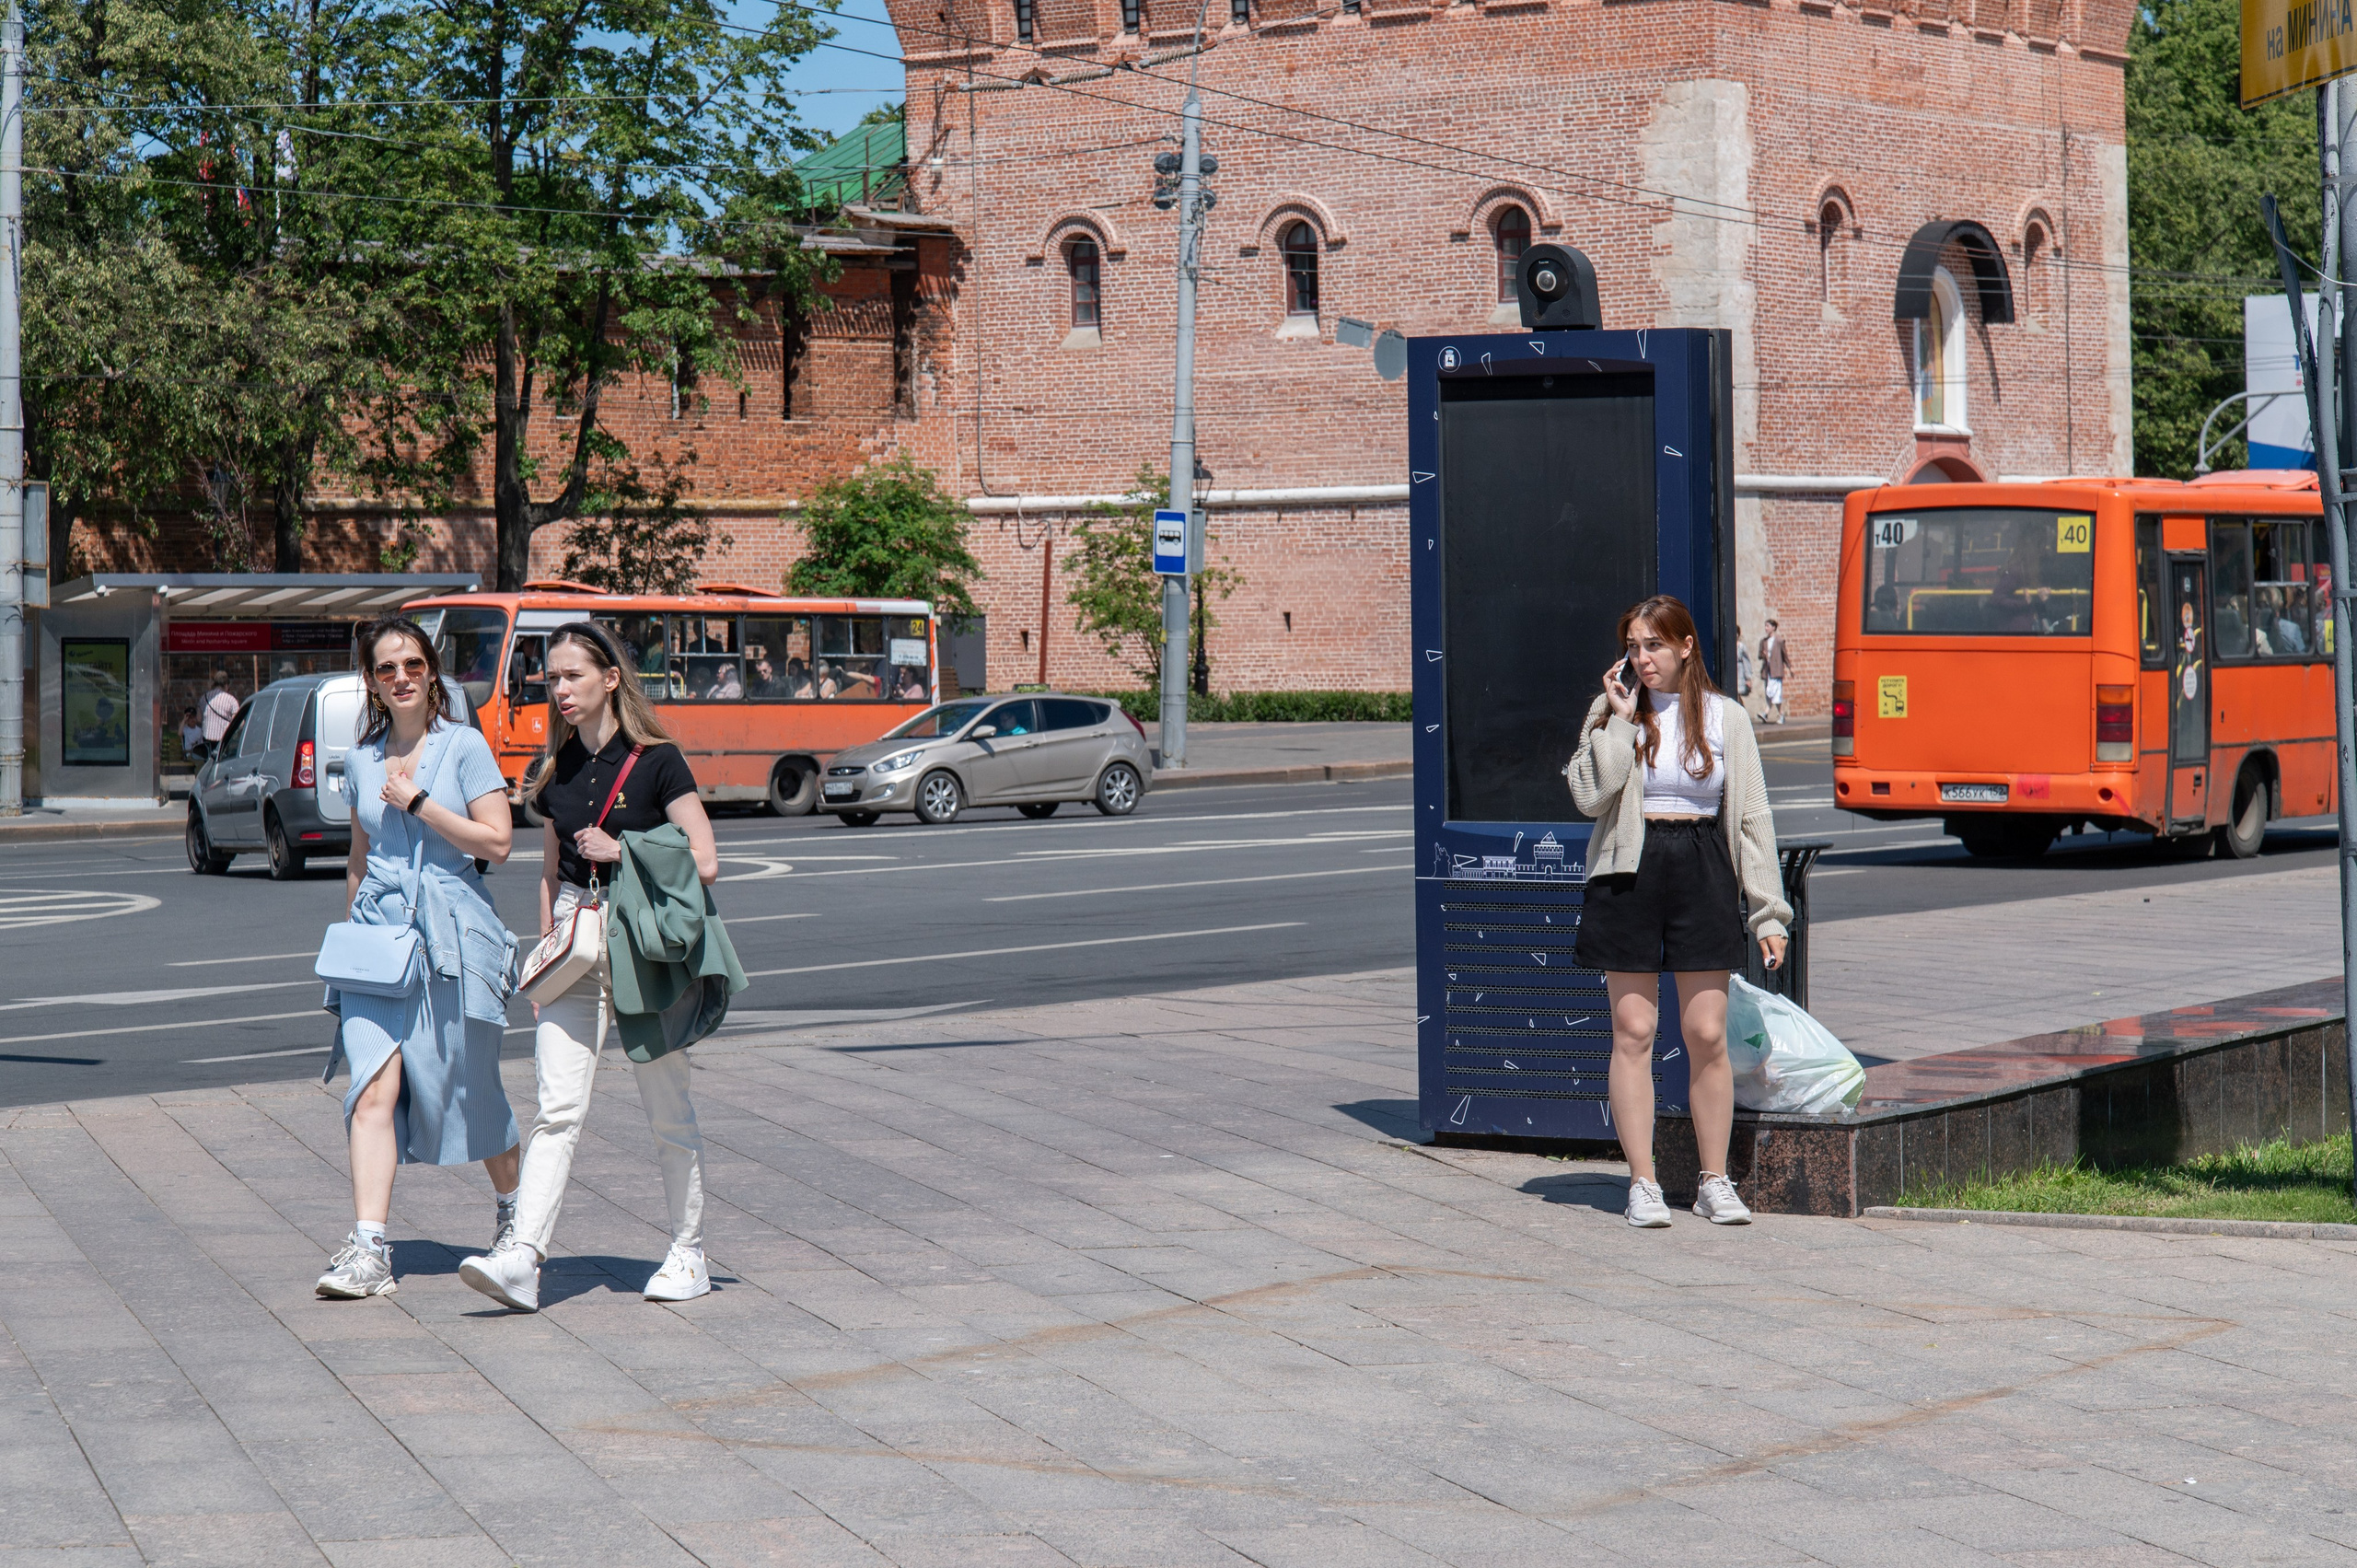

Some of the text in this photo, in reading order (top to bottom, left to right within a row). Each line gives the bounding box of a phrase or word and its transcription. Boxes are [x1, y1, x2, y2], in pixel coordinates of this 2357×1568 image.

[2267, 0, 2353, 61] на МИНИНА
[911, 621, 923, 633] 24
